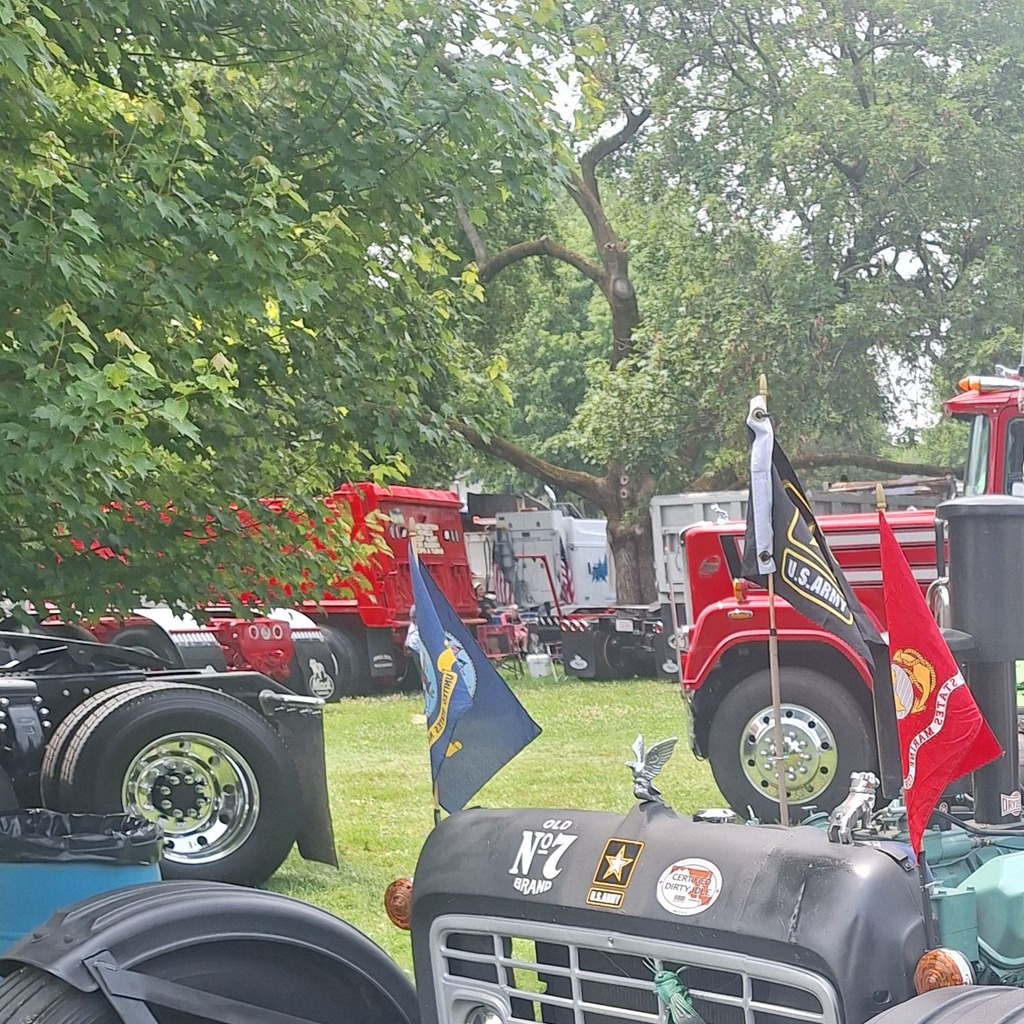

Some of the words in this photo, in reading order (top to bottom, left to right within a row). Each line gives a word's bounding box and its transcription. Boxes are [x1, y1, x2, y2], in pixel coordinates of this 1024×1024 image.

[543, 819, 573, 831] OLD
[672, 873, 712, 886] CERTIFIED
[513, 877, 553, 896] BRAND
[665, 882, 691, 892] DIRTY
[691, 886, 712, 896] IDLE
